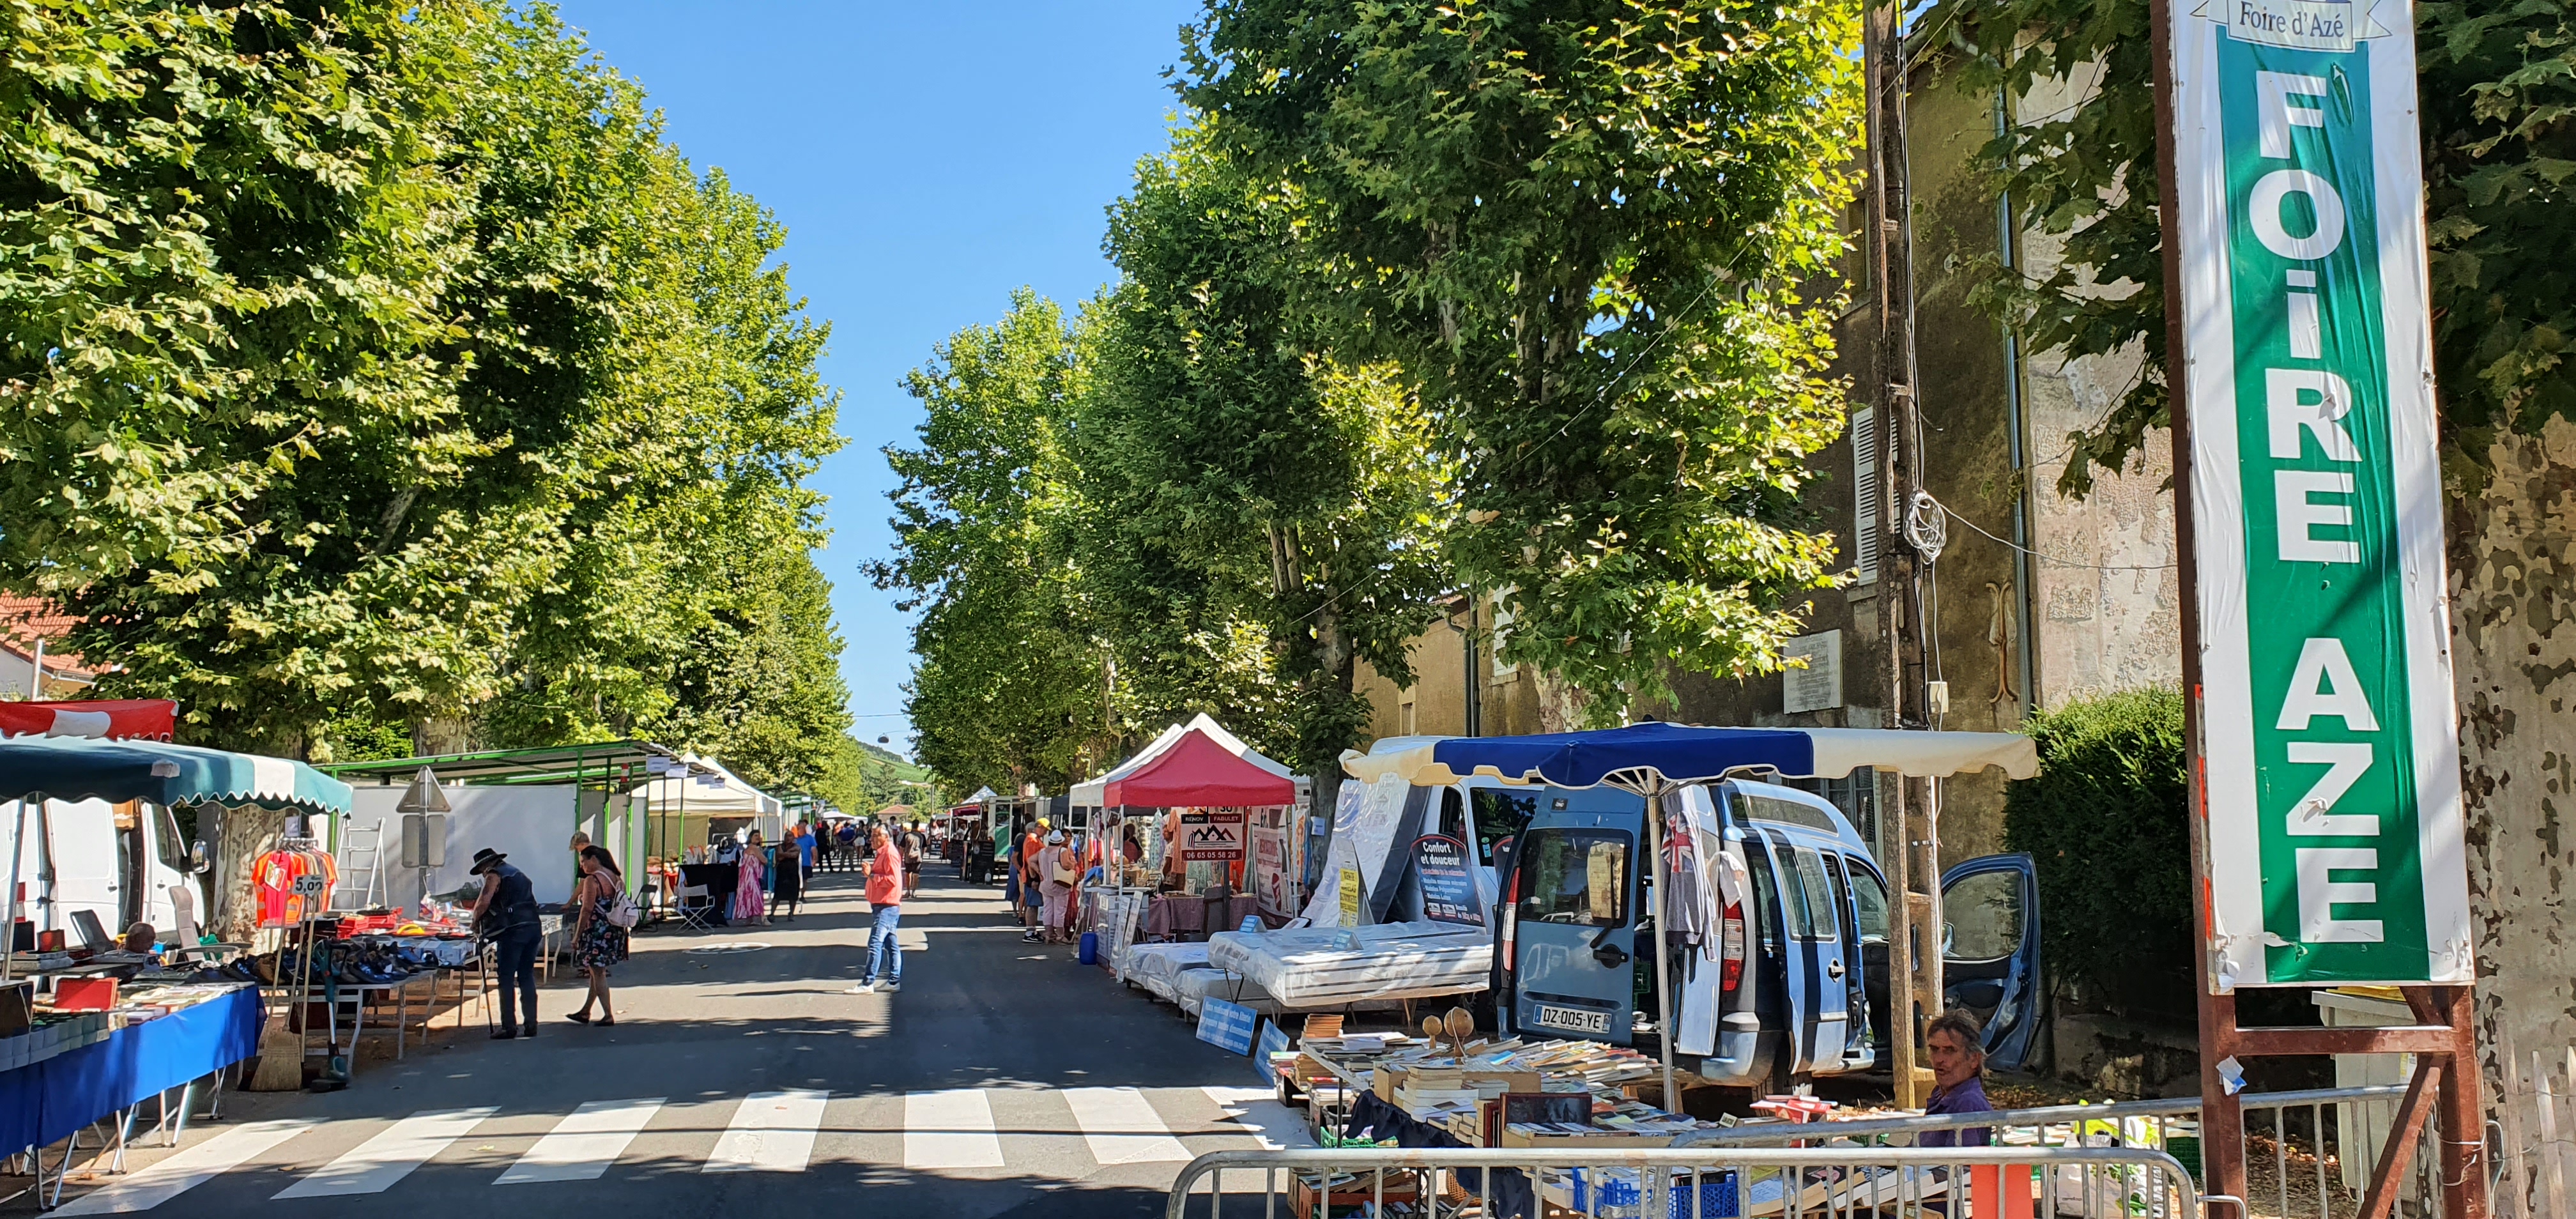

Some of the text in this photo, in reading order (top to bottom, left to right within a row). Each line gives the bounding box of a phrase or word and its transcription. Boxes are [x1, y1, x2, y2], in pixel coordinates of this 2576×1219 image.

[2239, 1, 2345, 38] Foire d'Azé
[2275, 637, 2384, 943] AZE
[1422, 841, 1452, 854] Confort
[1420, 854, 1460, 866] et douceur
[1543, 1008, 1601, 1029] DZ-005-YE
